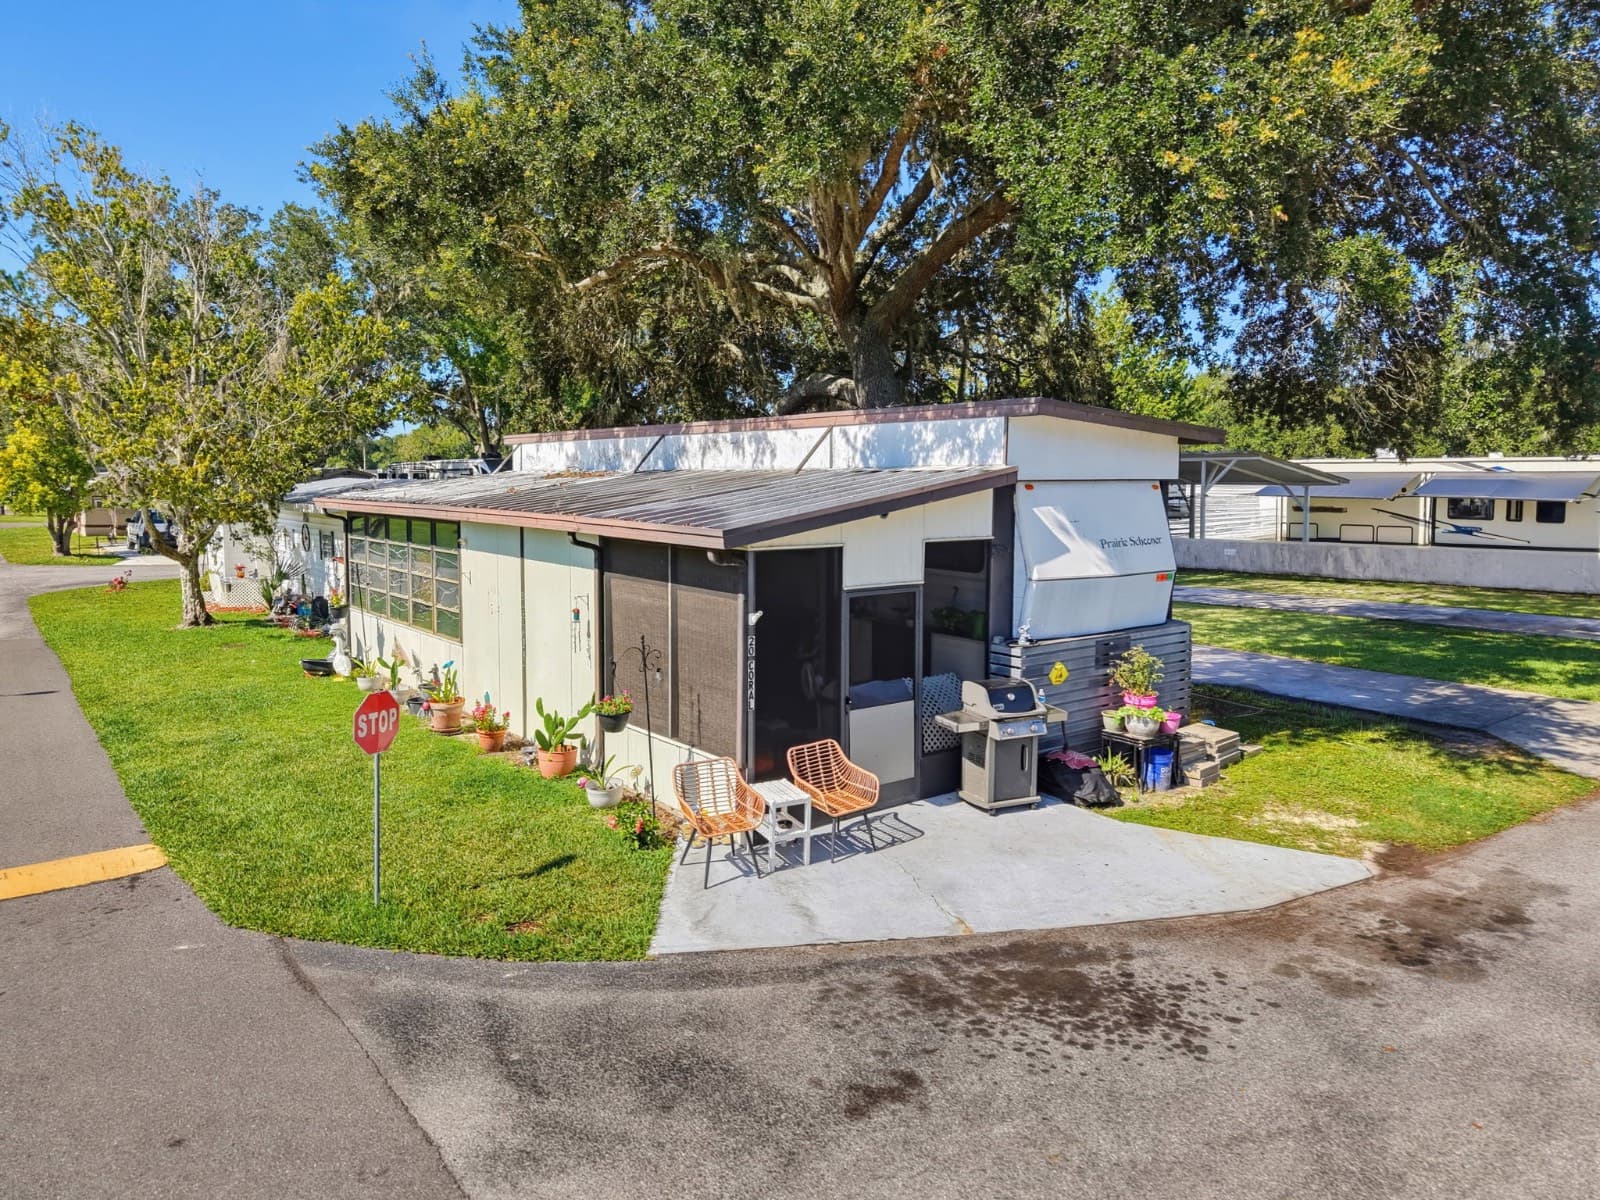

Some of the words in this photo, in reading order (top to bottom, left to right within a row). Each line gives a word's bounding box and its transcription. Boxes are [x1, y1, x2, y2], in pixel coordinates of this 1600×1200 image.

[1100, 538, 1128, 549] Prairie
[748, 636, 755, 656] 20
[357, 707, 398, 738] STOP
